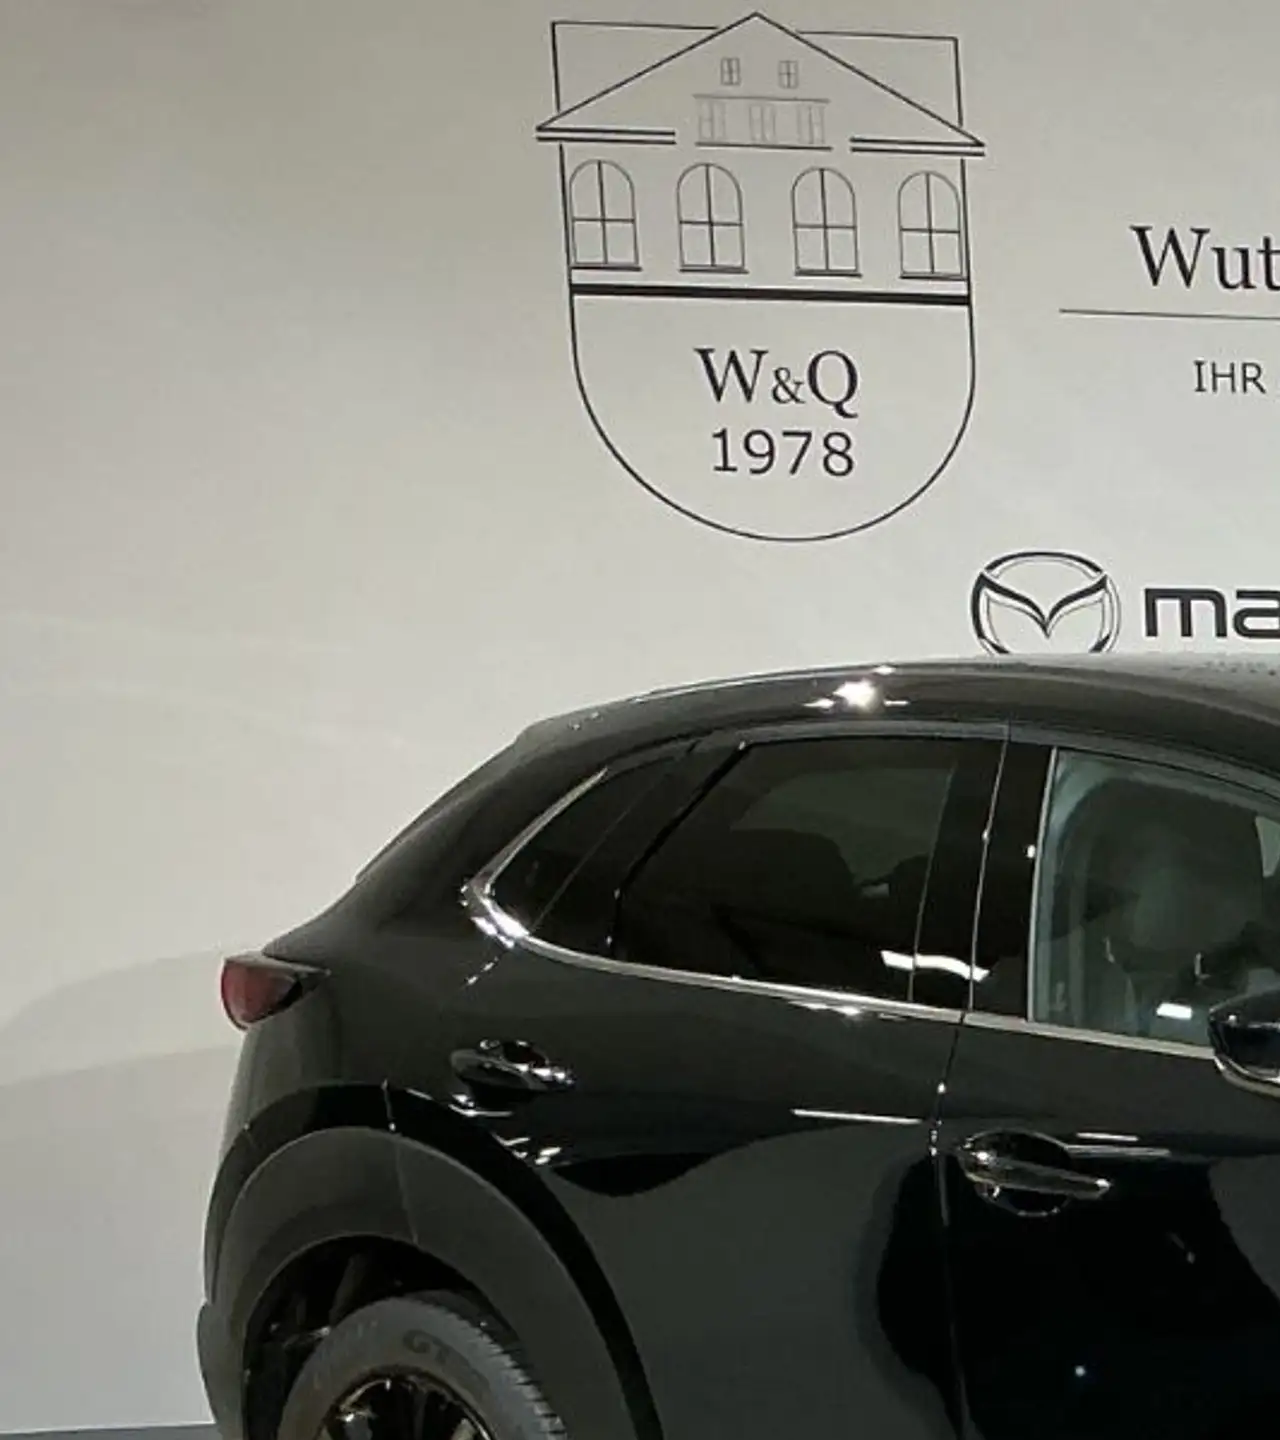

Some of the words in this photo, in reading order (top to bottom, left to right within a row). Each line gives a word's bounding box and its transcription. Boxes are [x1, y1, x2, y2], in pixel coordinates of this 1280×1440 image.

[693, 348, 859, 418] W&Q
[1194, 360, 1267, 396] IHR
[712, 428, 855, 477] 1978
